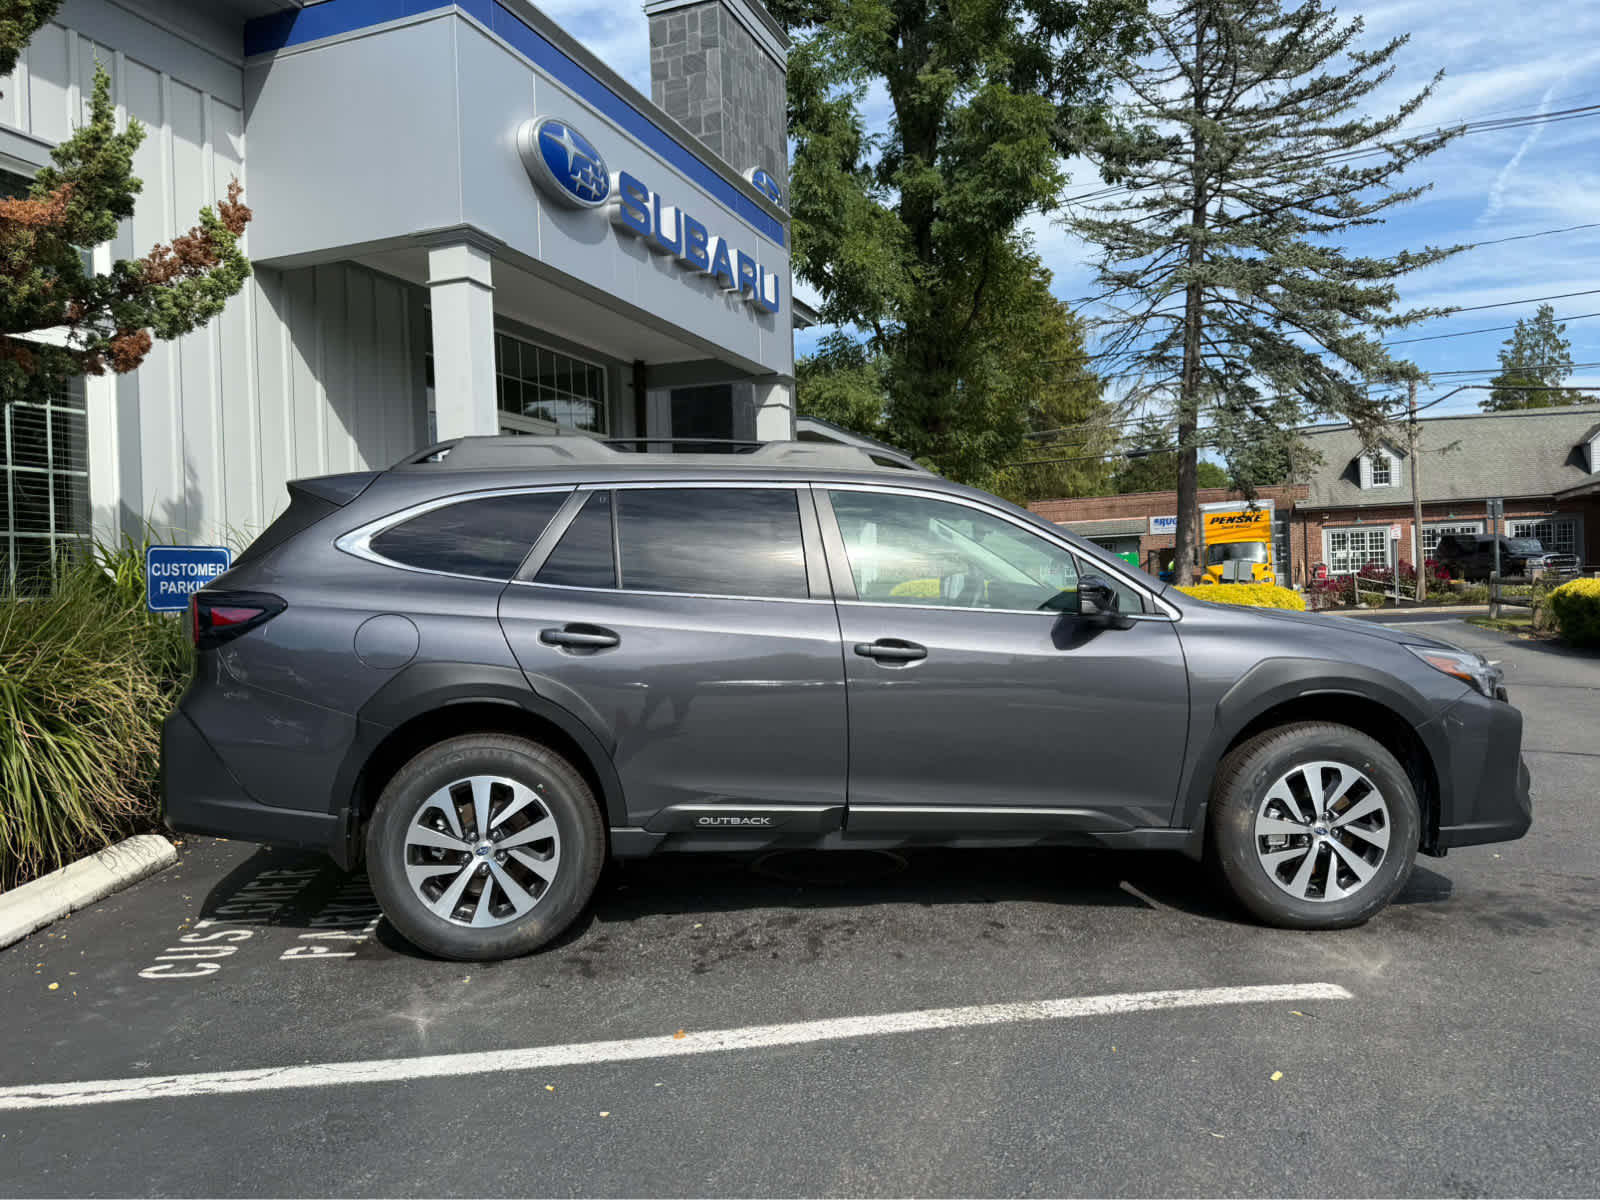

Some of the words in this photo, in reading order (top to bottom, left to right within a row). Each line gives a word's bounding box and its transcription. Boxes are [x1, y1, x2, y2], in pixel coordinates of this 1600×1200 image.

[618, 170, 779, 313] SUBARU
[1210, 514, 1262, 524] PENSKE
[151, 563, 225, 577] CUSTOMER
[698, 817, 770, 825] OUTBACK
